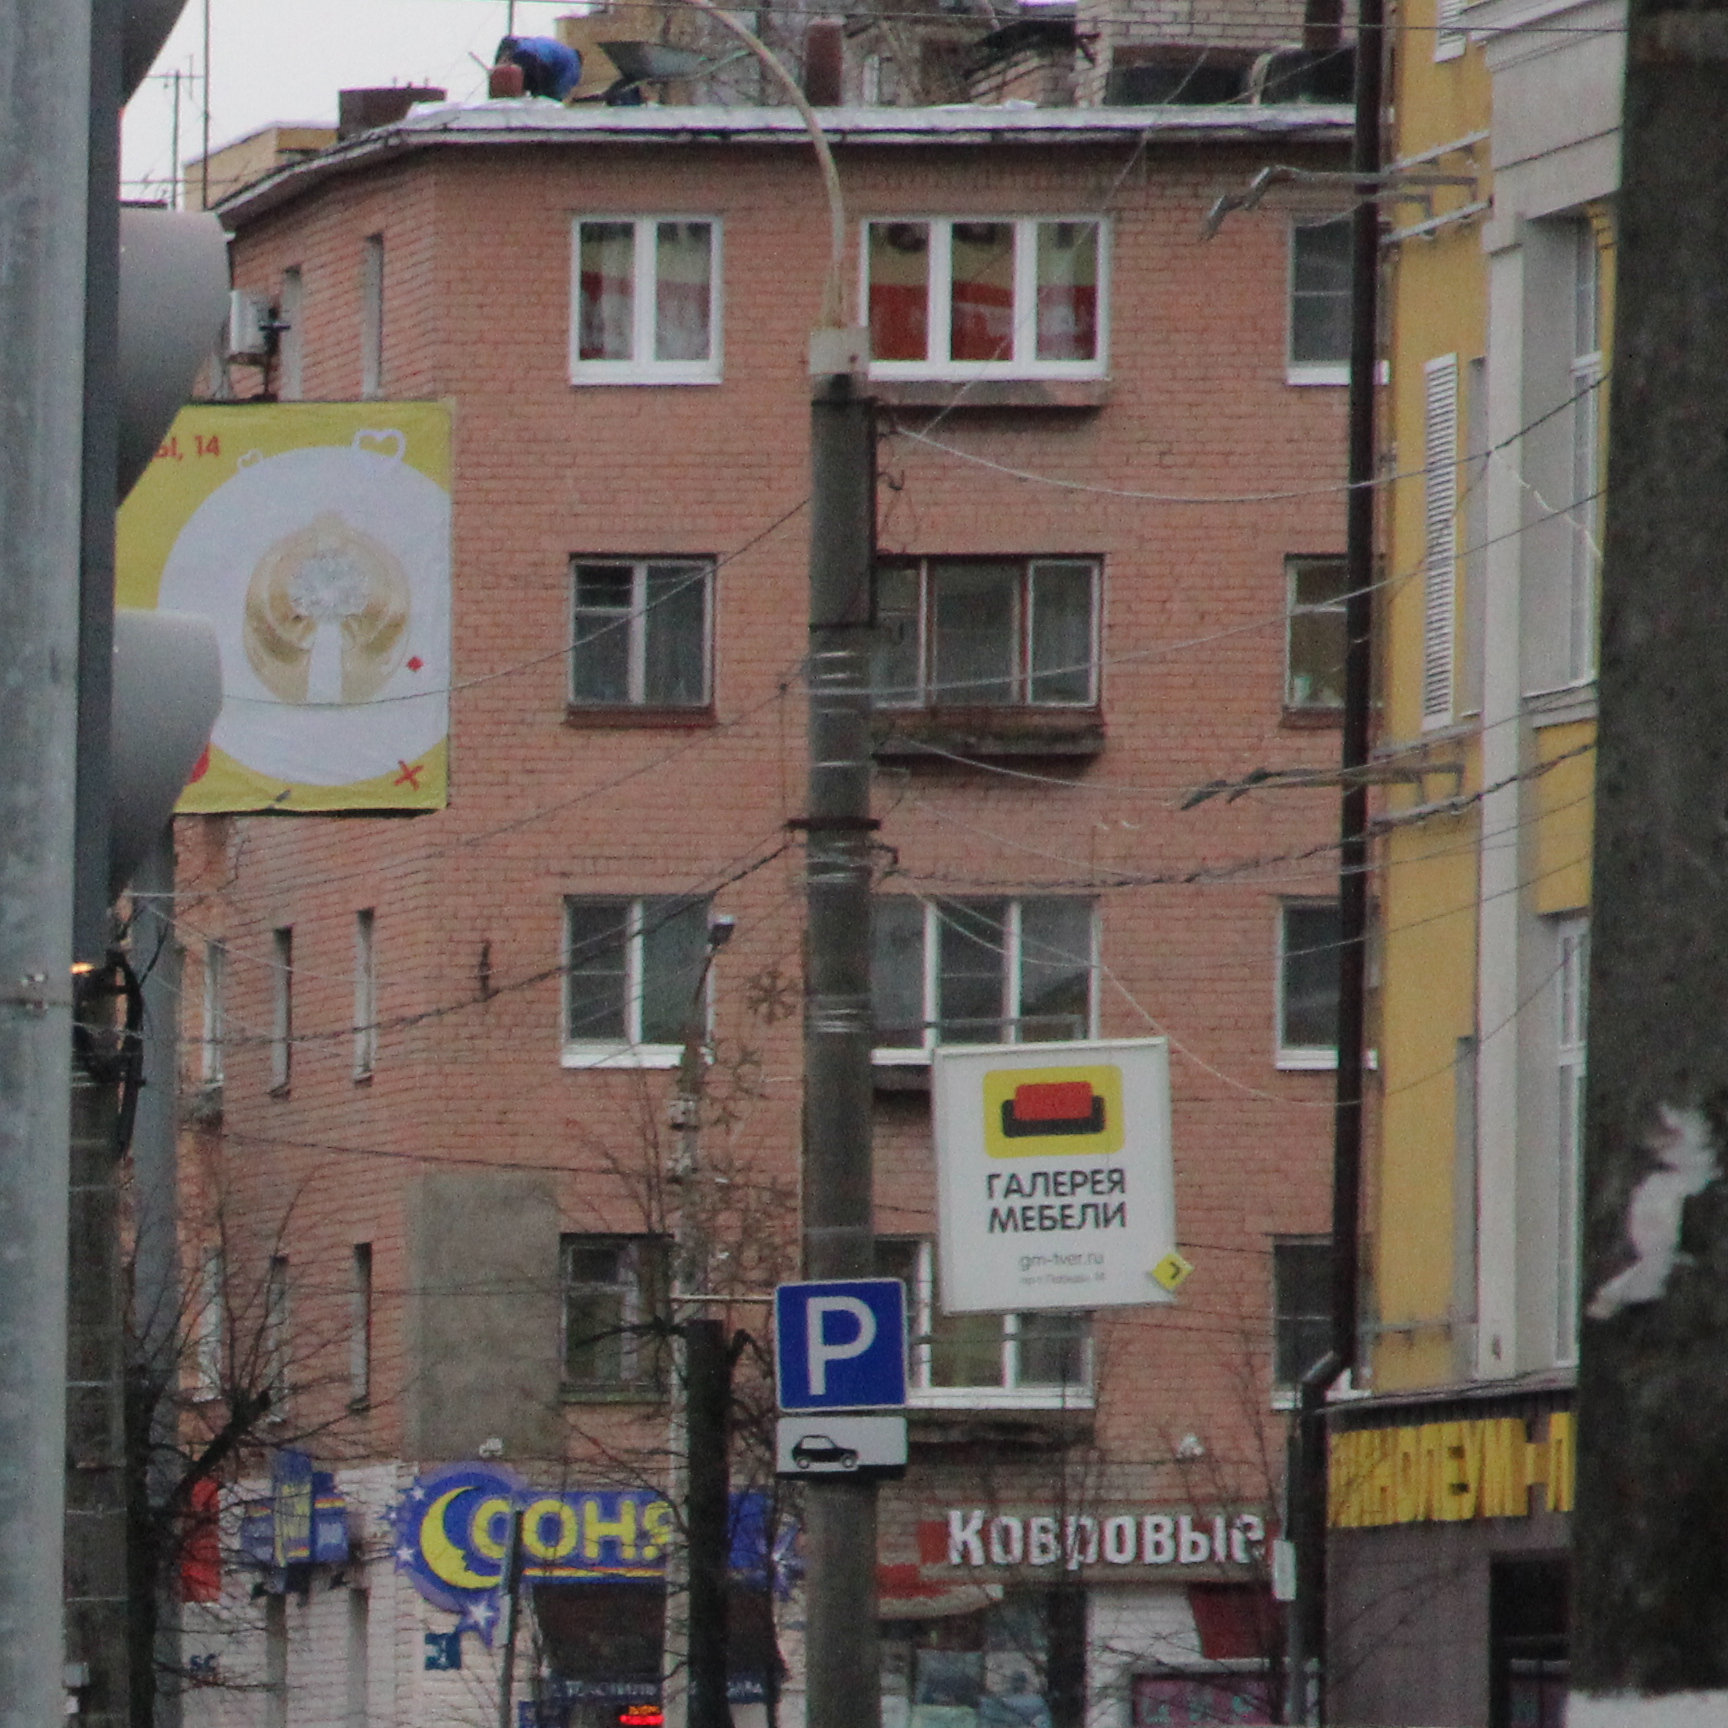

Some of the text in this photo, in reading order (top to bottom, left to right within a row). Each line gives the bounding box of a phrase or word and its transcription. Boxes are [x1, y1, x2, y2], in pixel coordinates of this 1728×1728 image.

[194, 434, 221, 457] 14
[986, 1167, 1127, 1200] ГАЛЕРЕЯ
[987, 1201, 1127, 1234] МЕБЕЛИ
